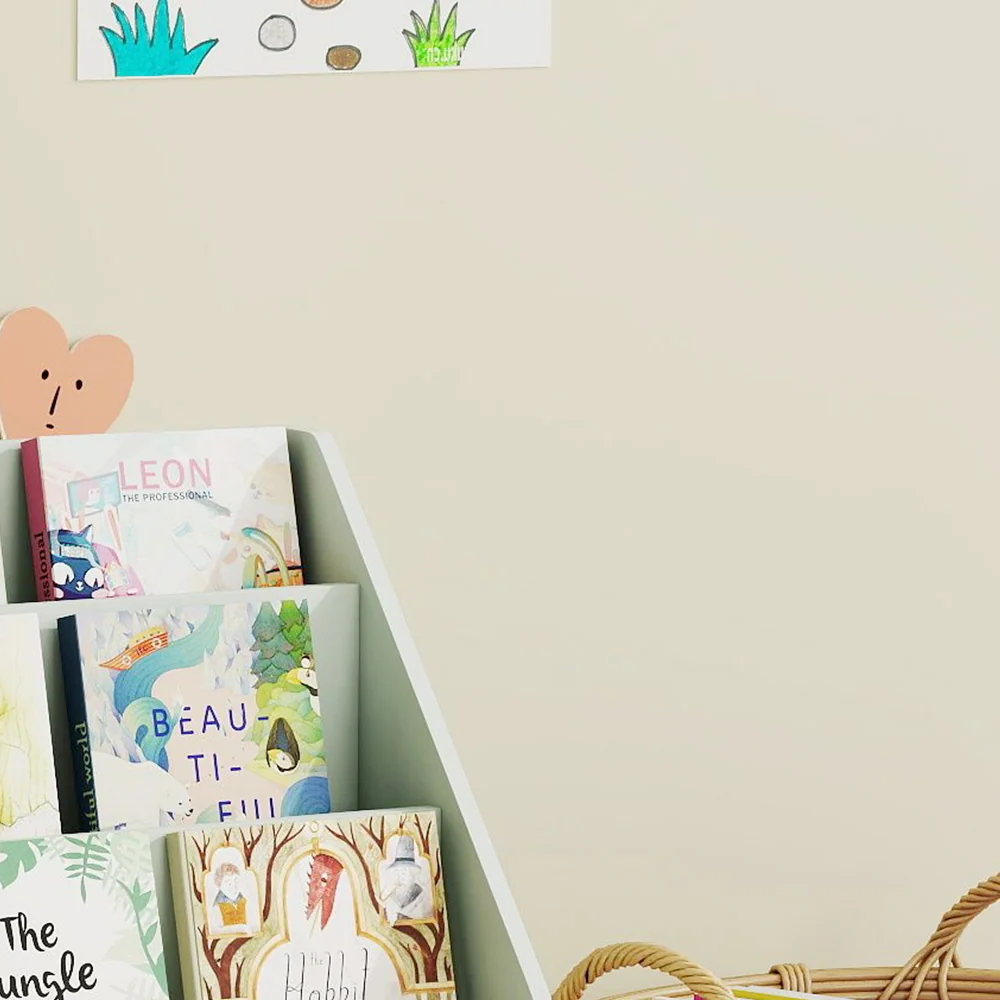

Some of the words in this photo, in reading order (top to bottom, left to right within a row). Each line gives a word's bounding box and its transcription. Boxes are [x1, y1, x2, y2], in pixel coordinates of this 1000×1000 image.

[118, 458, 213, 491] LEON
[122, 493, 140, 503] THE
[142, 490, 213, 502] PROFESSIONAL
[33, 532, 52, 600] ssional
[152, 702, 269, 738] BEAU-
[74, 722, 92, 784] world
[187, 753, 242, 783] TI-
